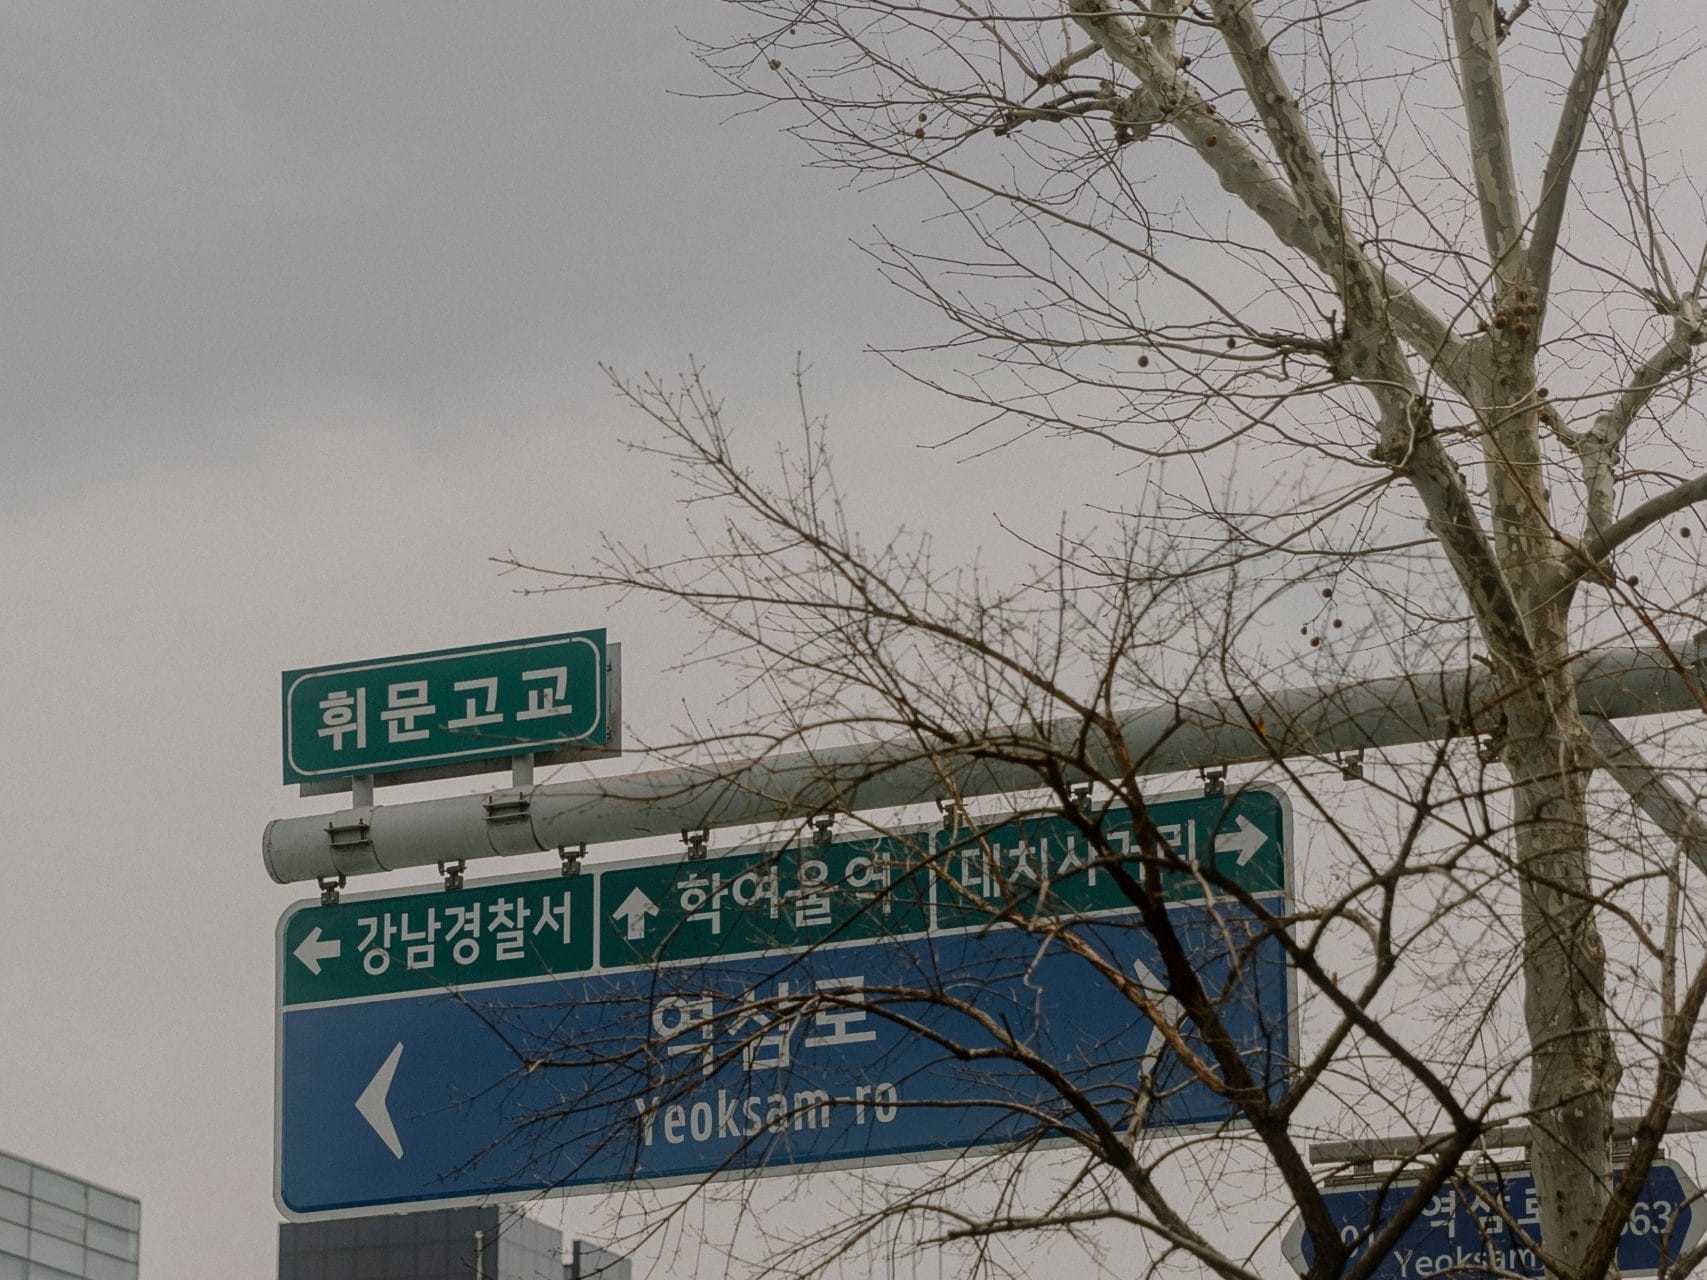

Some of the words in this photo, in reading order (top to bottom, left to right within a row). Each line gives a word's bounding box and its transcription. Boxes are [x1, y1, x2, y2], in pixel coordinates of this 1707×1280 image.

[317, 666, 573, 751] 휘문고교
[356, 891, 571, 976] 강남경찰서
[676, 851, 892, 935] 학여울역
[652, 976, 877, 1076] 역삼로
